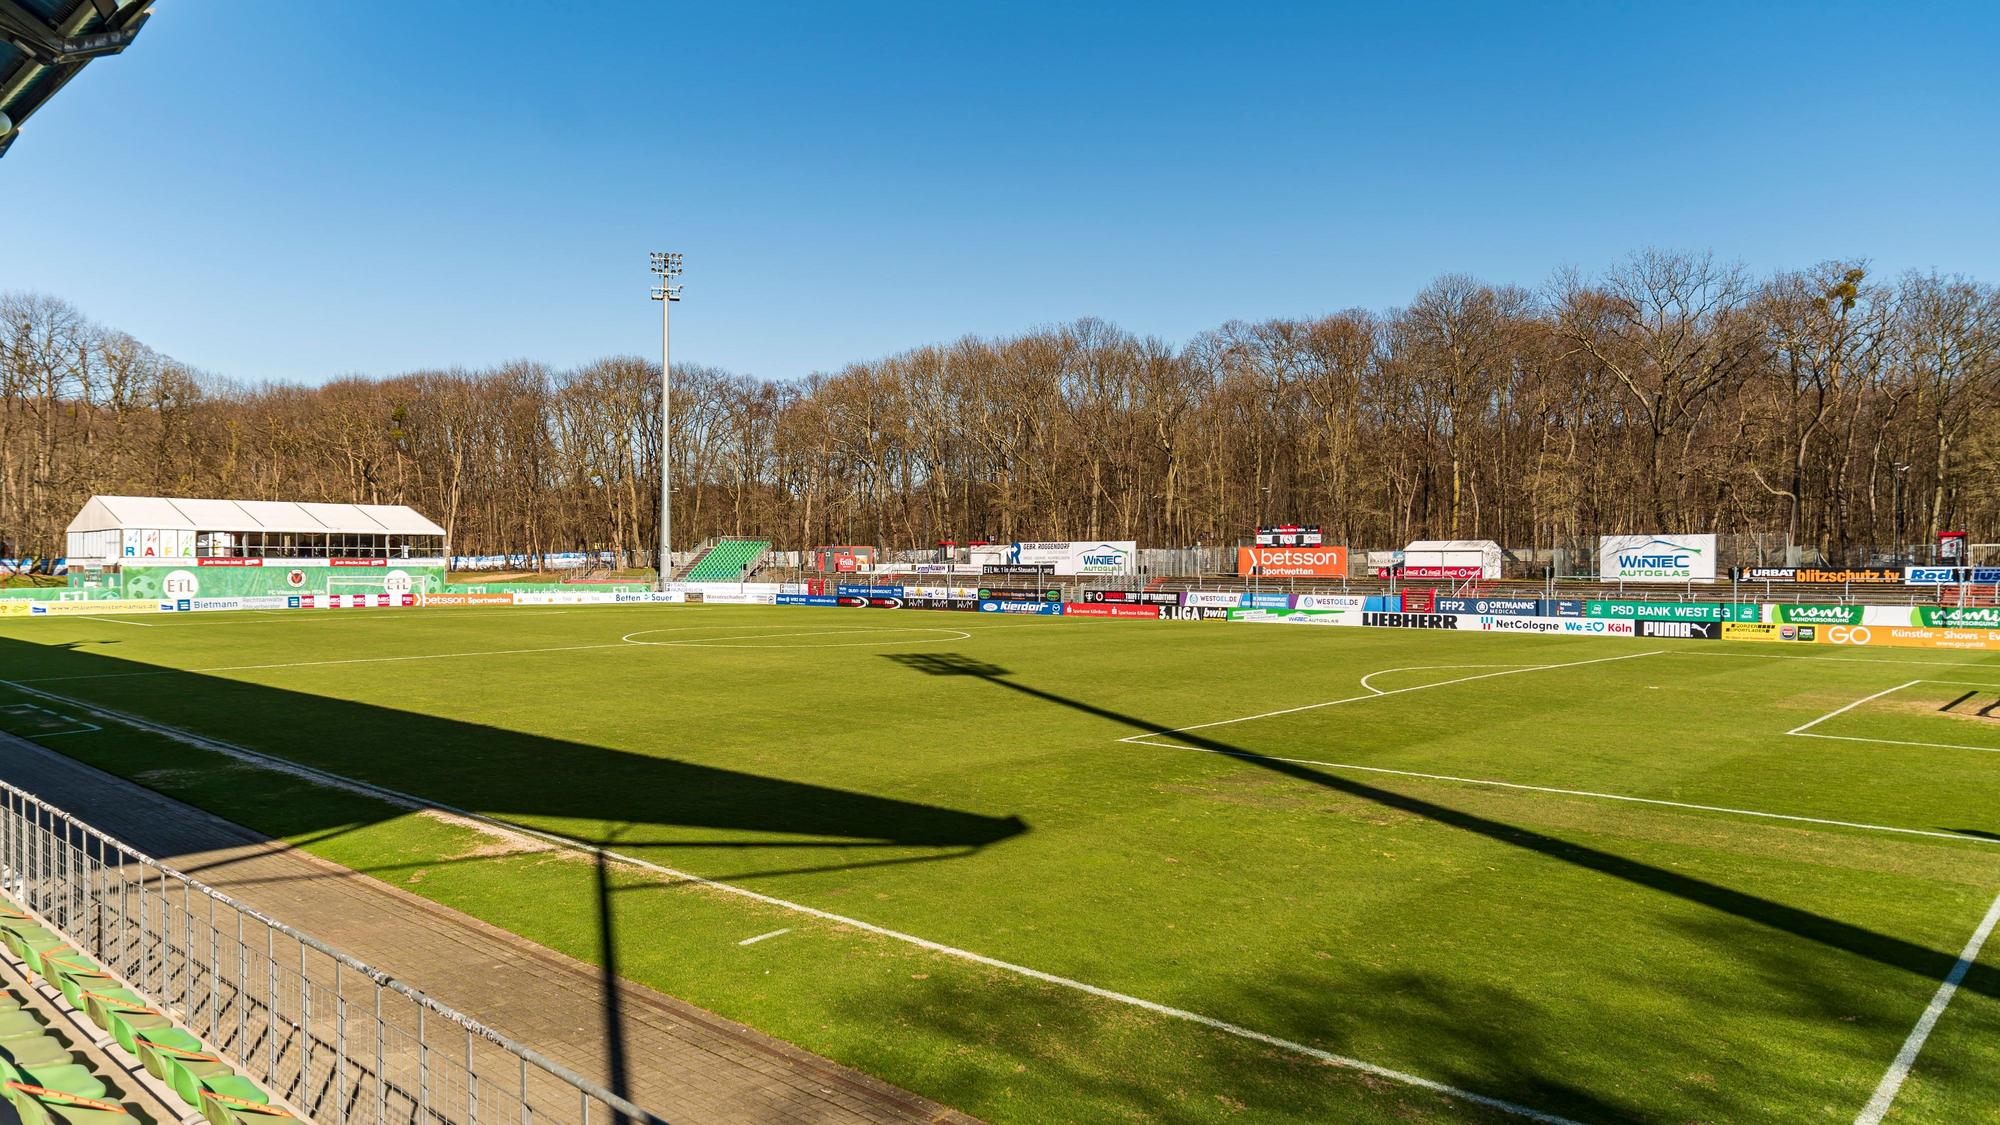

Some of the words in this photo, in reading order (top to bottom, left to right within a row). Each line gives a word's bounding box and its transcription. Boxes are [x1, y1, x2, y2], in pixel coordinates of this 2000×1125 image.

[1261, 549, 1337, 565] betsson
[1262, 566, 1314, 577] Sportwetten
[1752, 569, 1795, 577] URBAT
[1796, 569, 1900, 583] blitzschutz.tv
[167, 578, 195, 593] ETL
[424, 595, 465, 604] betsson
[616, 594, 641, 602] Betten
[1316, 598, 1358, 606] WESTOEL.DE
[194, 601, 238, 609] Bietmann
[1000, 601, 1049, 612] kierdorf
[1440, 601, 1465, 611] FFP2
[1159, 607, 1170, 620] 3.
[1171, 606, 1201, 621] LIGA
[1203, 607, 1228, 619] bwin
[1610, 605, 1634, 615] PSD
[1637, 606, 1671, 616] BANK
[1674, 607, 1710, 617] WEST
[1712, 608, 1731, 618] EG
[1789, 606, 1854, 619] nomi
[1363, 613, 1458, 629] LIEBHERR
[1496, 620, 1559, 632] NetCologne
[1565, 621, 1582, 631] We
[1608, 623, 1632, 632] Köln
[1643, 621, 1692, 637] PUMA
[1891, 630, 1933, 638] Künstler
[1944, 631, 1978, 639] Shows
[1829, 626, 1871, 645] GO
